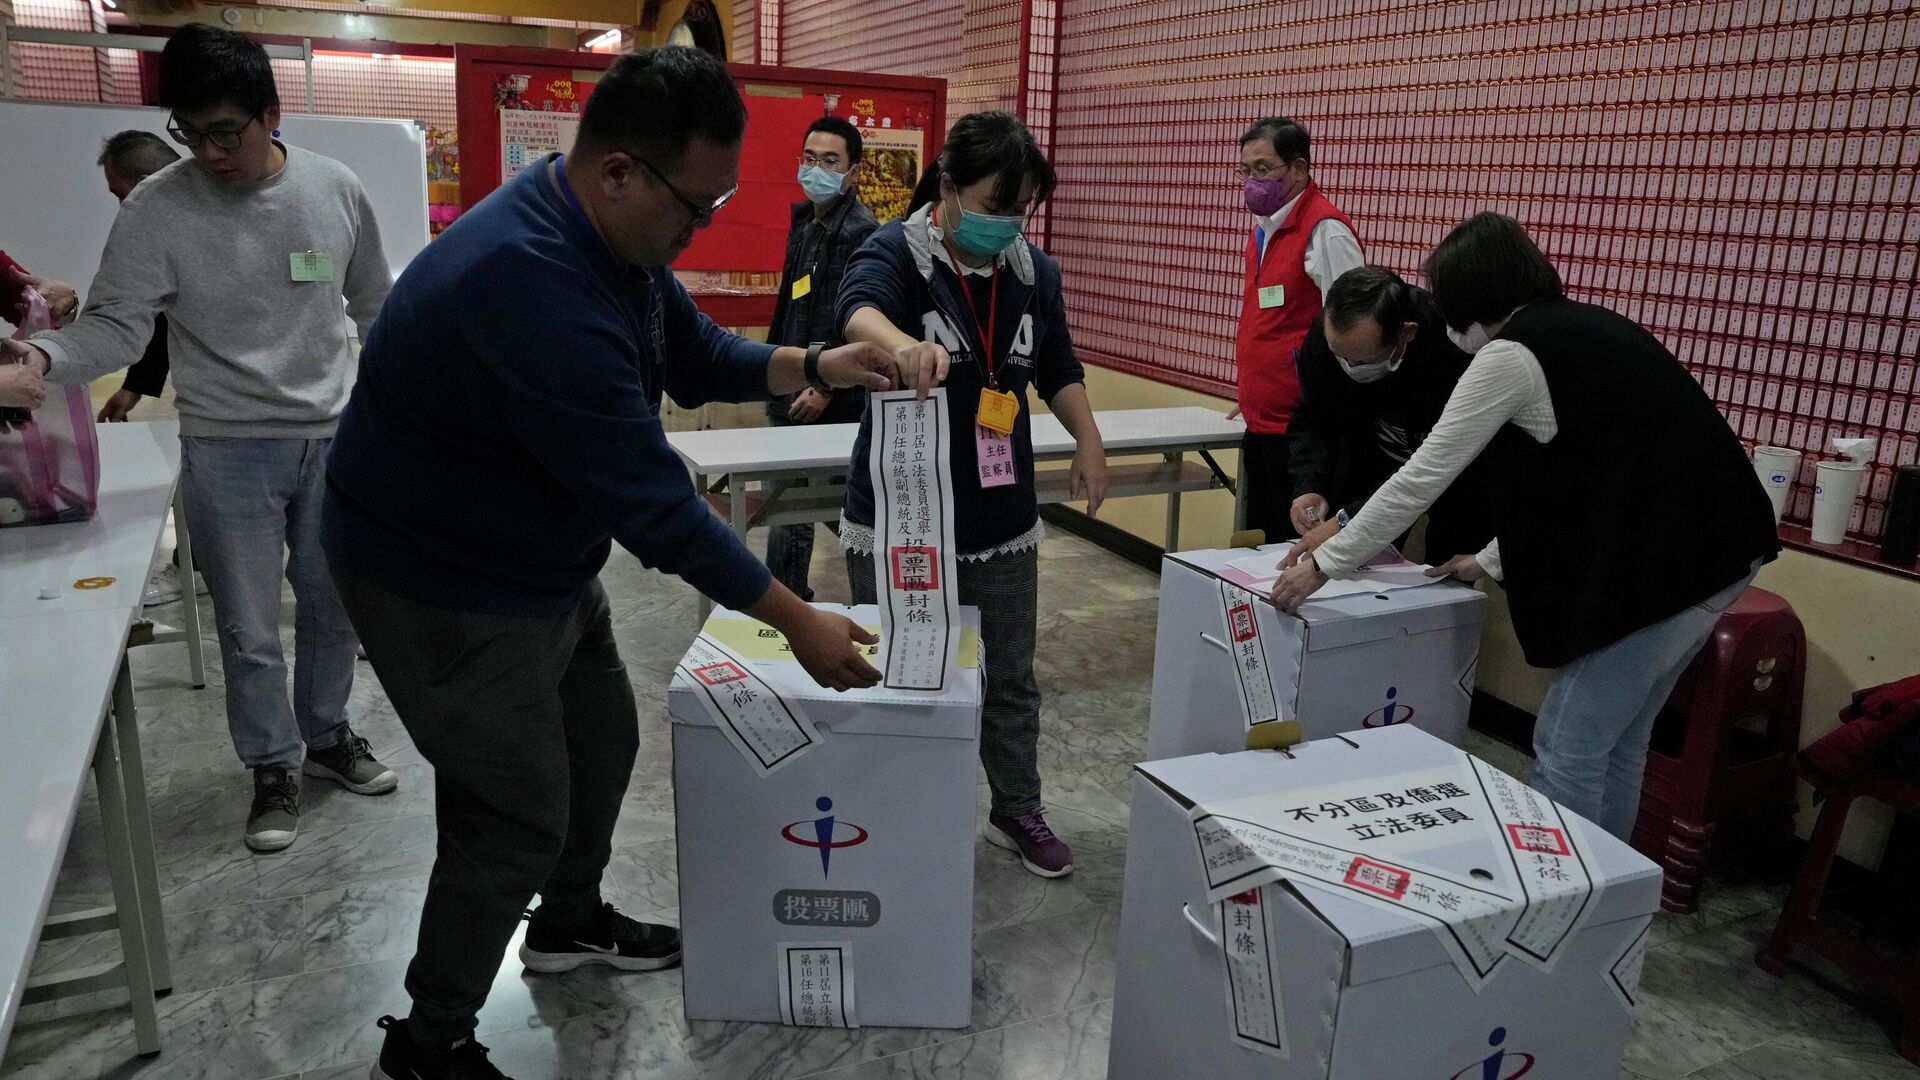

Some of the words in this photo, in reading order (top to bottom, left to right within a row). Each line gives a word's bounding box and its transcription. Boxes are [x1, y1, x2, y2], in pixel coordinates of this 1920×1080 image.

[981, 461, 1013, 478] 監察員
[986, 444, 1007, 457] 主任
[891, 406, 912, 535] 第16任總統副總統及
[911, 405, 932, 536] 第11屆立法委員選舉
[1284, 781, 1471, 823] 不分區及僑選
[1347, 806, 1474, 840] 立法委員
